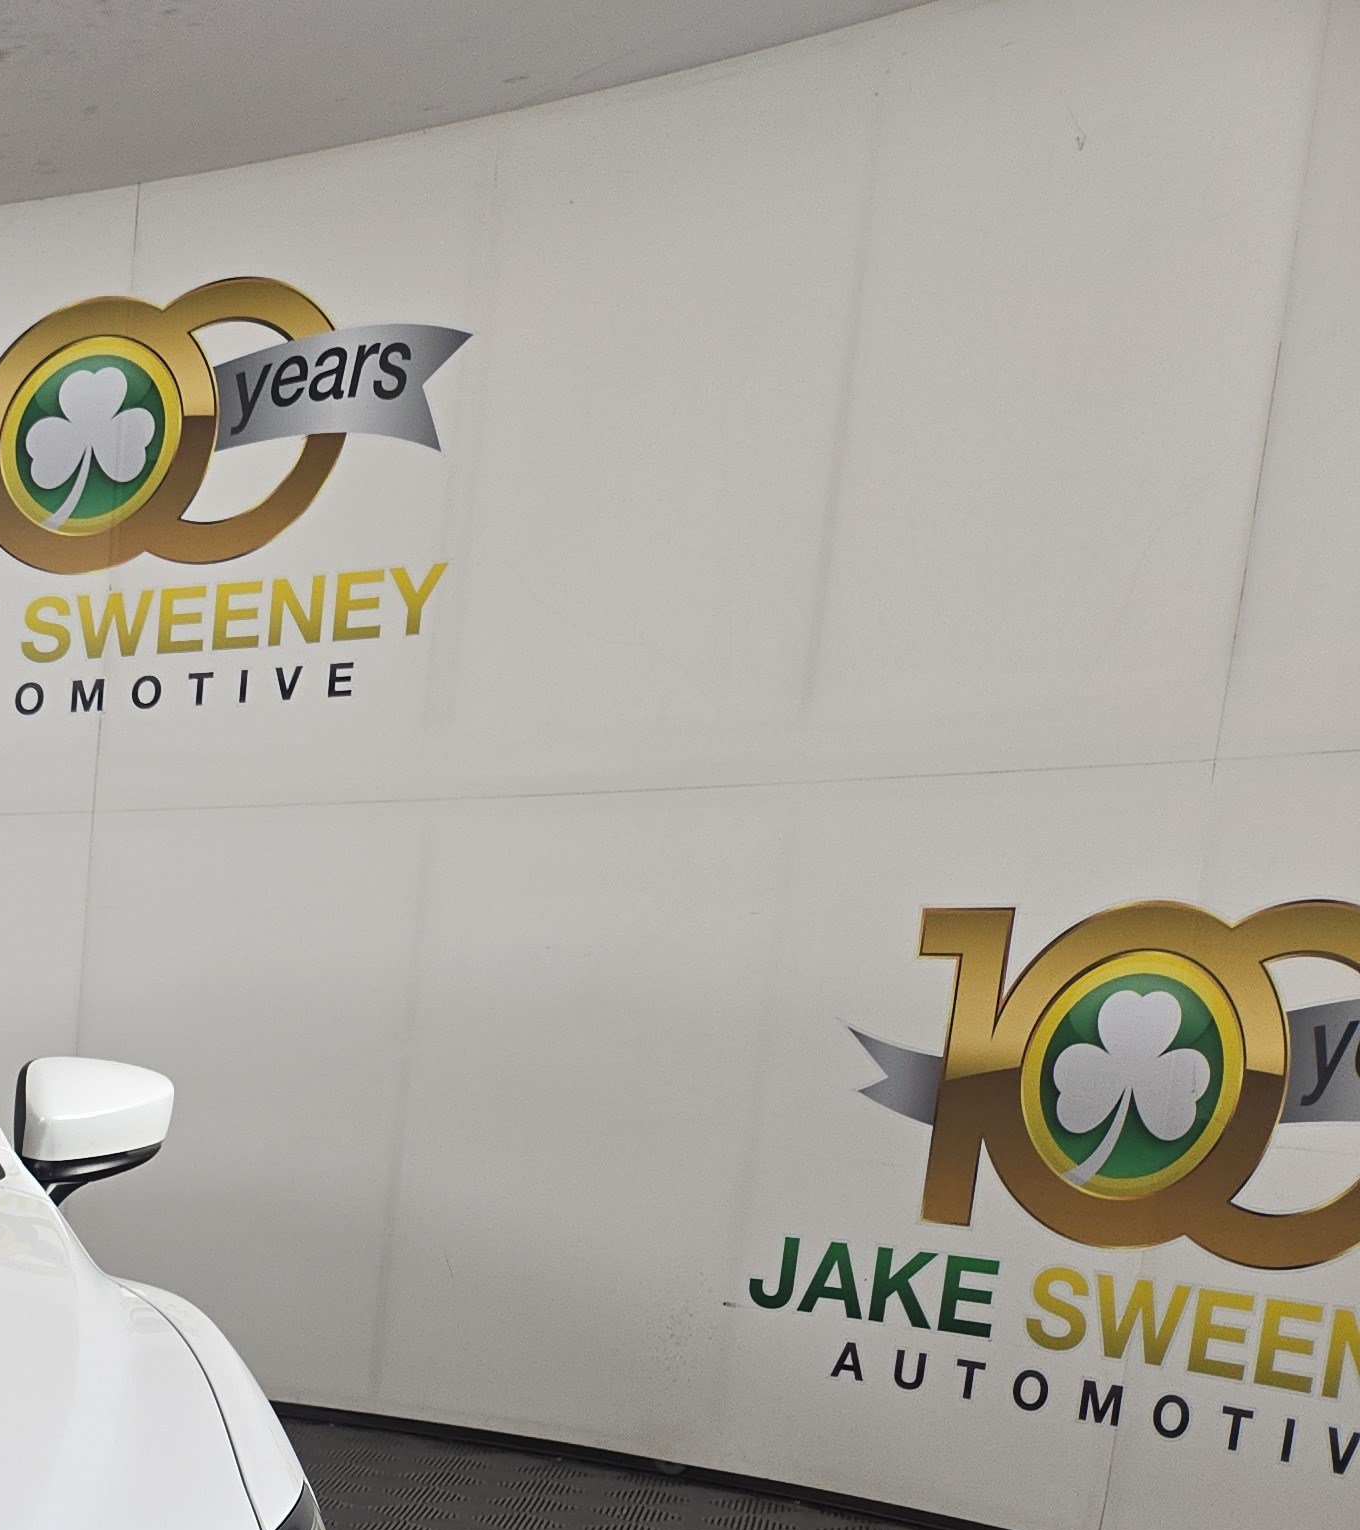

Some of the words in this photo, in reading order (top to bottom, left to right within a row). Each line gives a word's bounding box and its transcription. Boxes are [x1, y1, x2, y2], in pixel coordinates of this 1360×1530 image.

[230, 341, 412, 435] years
[20, 562, 449, 664] SWEENEY
[748, 1236, 1000, 1338] JAKE
[830, 1341, 1360, 1474] AUTOMOTIV
